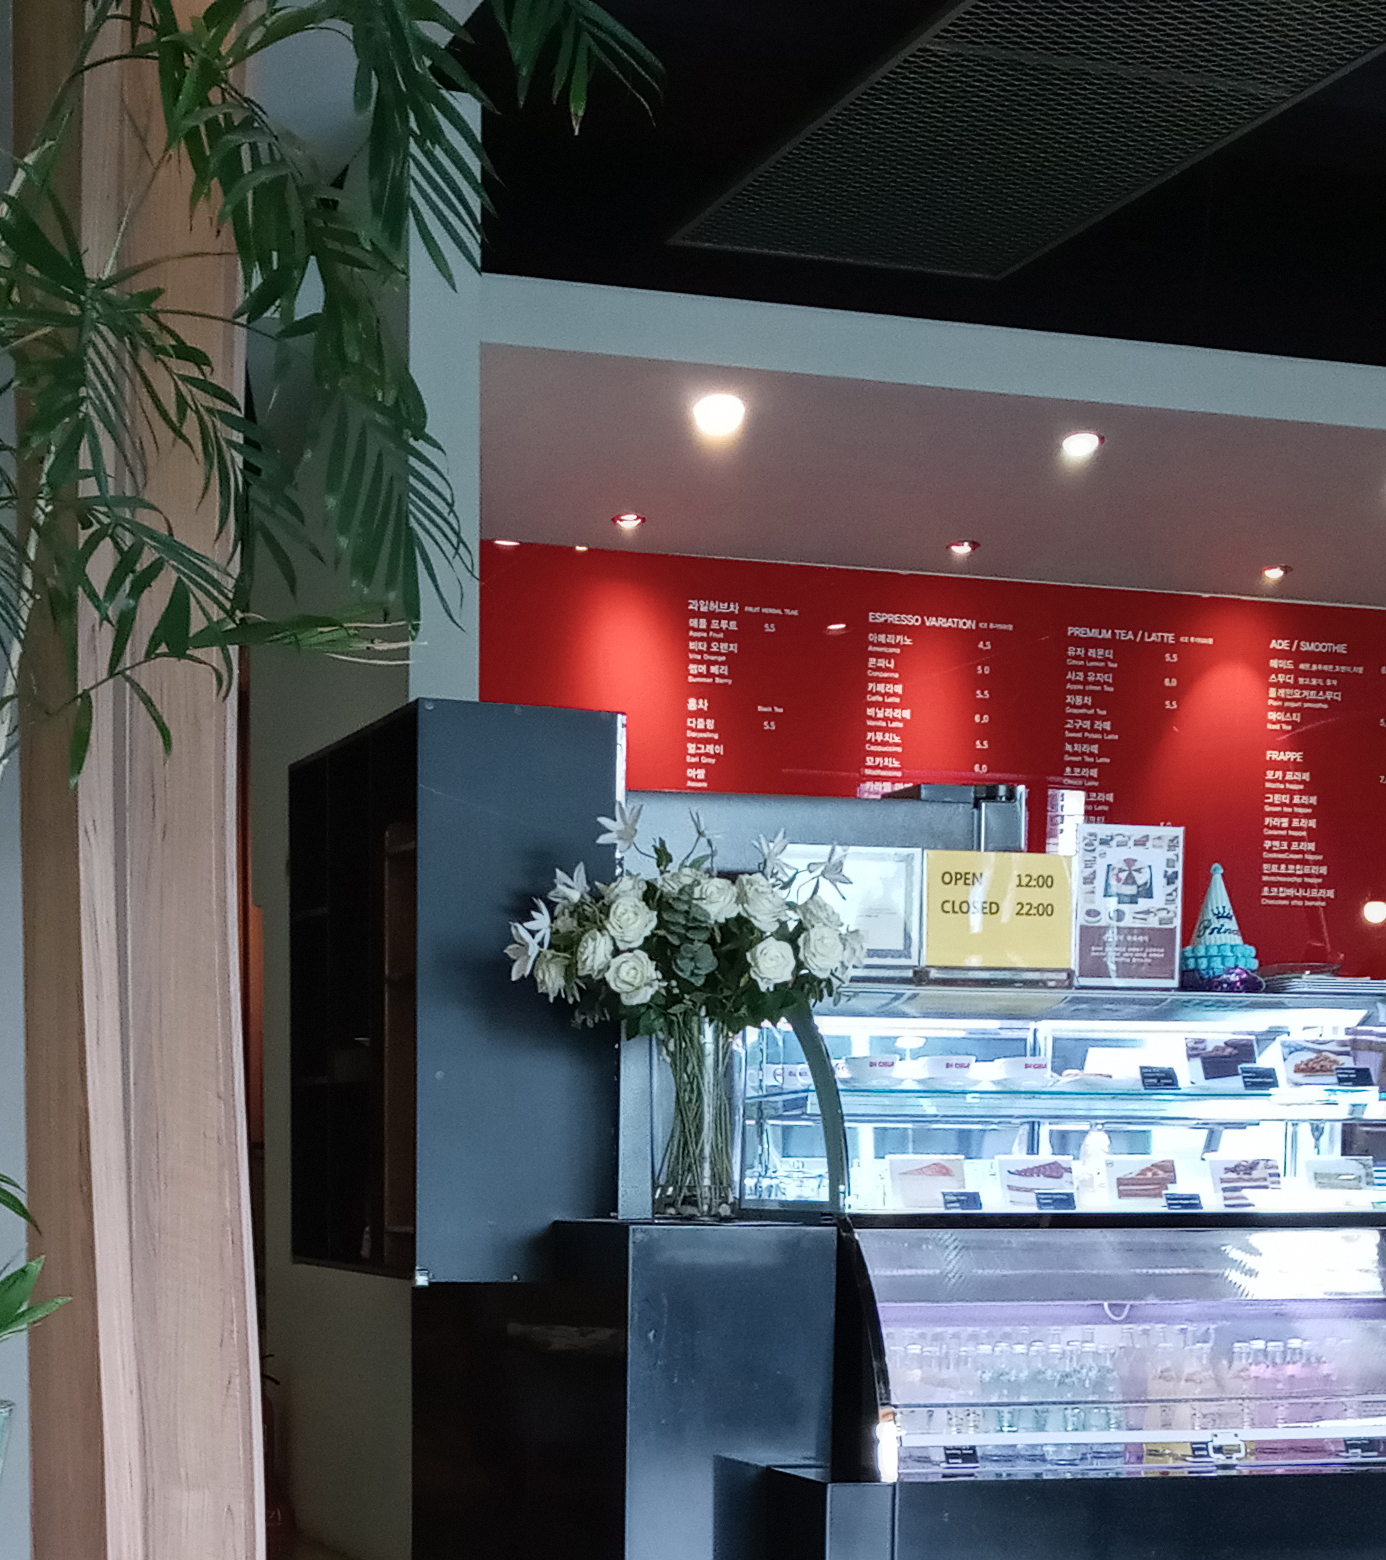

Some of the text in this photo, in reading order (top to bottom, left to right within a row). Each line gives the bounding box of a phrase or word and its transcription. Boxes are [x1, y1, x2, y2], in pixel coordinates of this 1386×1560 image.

[688, 599, 739, 614] 과일허브차
[868, 612, 976, 630] ESPRESSO VARIATION
[868, 633, 913, 645] 아메리카노
[1067, 626, 1112, 639] PREMIUM
[1114, 629, 1134, 641] TEA
[1144, 632, 1175, 644] LATTE
[1270, 639, 1290, 650] ADE
[1300, 641, 1348, 654] SMOOTHIE
[1268, 673, 1294, 684] 스무디
[687, 698, 709, 711] 홍차
[1267, 711, 1301, 722] 아이스티
[866, 731, 902, 743] 카푸치노
[686, 743, 724, 755] 얼그레이
[1266, 750, 1304, 762] FRAPPE
[941, 871, 1054, 889] OPEN 12:00
[941, 900, 1054, 917] CLOSED 22:00
